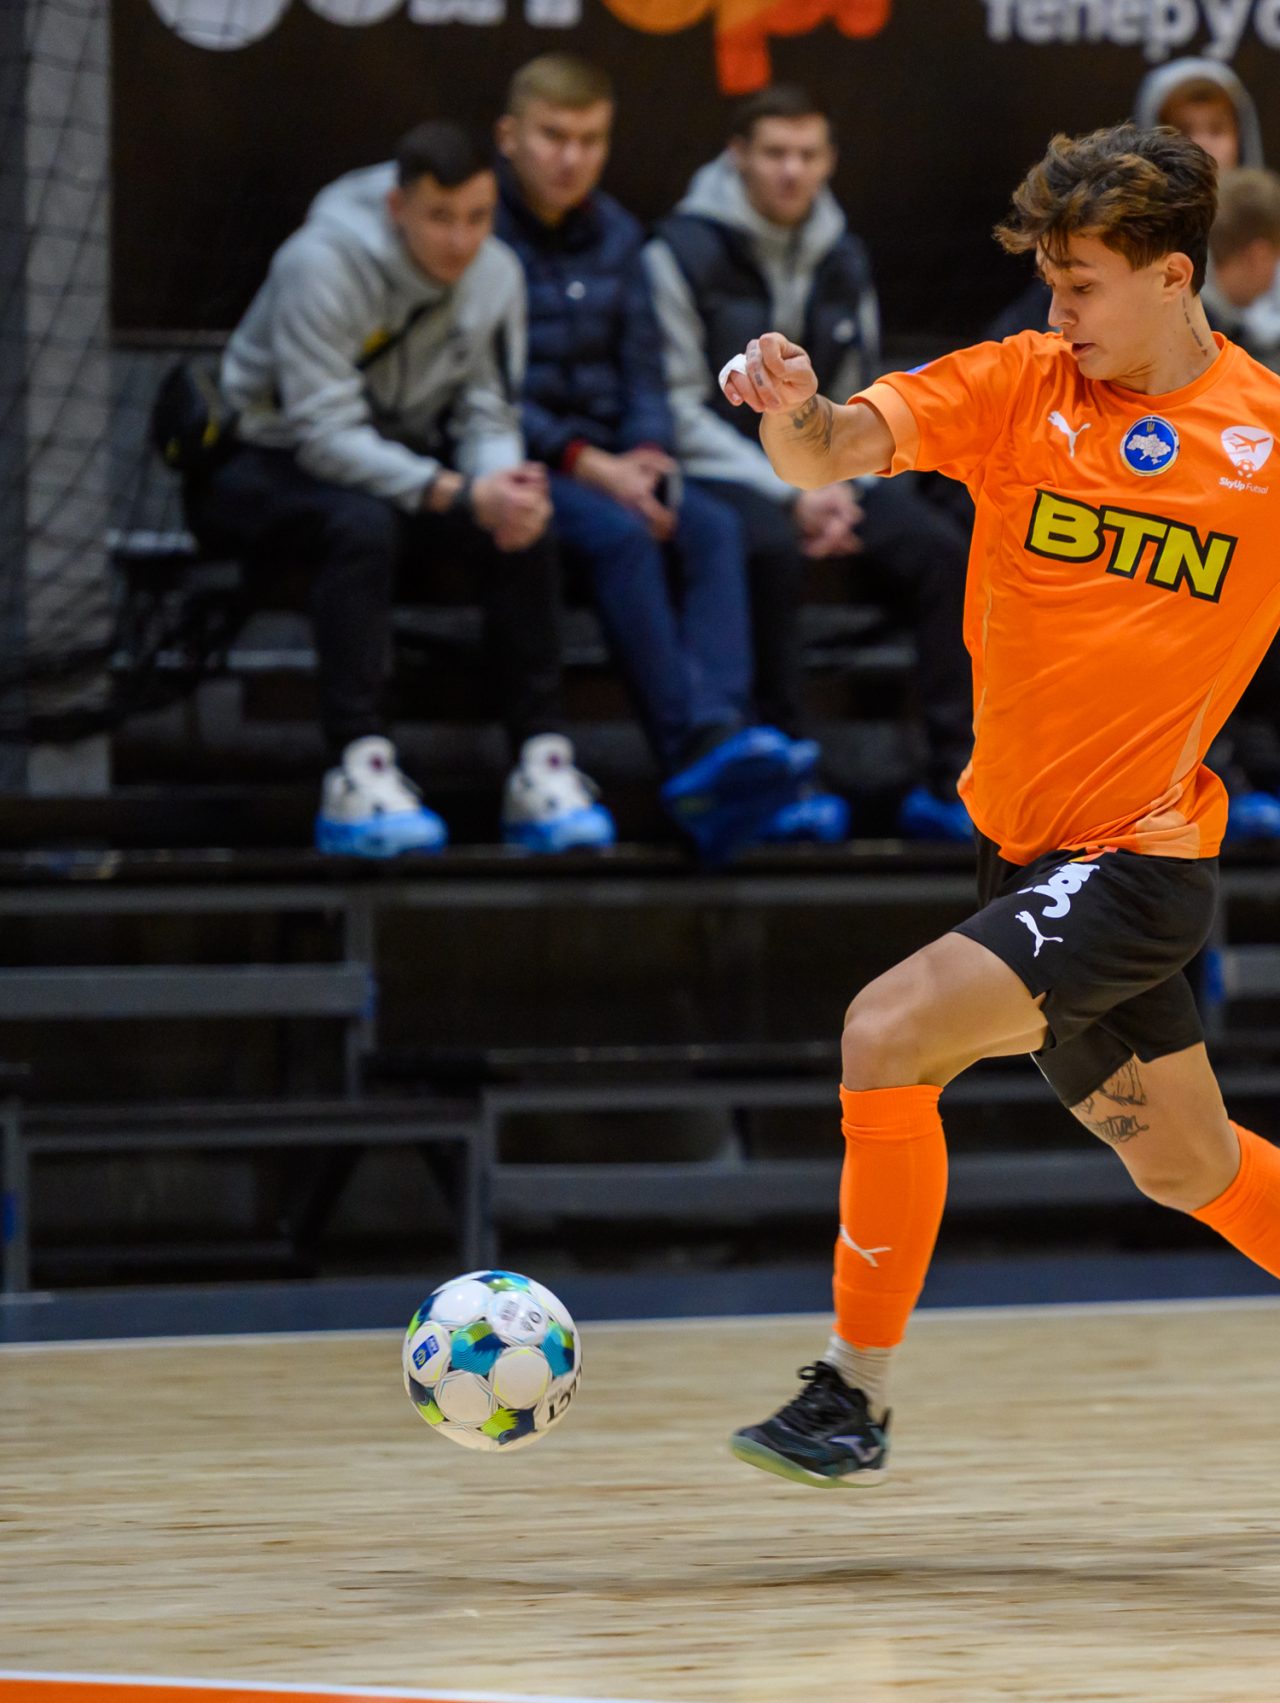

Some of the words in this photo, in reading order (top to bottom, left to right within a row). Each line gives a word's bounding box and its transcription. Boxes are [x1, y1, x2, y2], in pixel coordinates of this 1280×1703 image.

[1218, 476, 1246, 492] SkyUp
[1246, 482, 1269, 495] Futsal
[1024, 488, 1239, 604] BTN
